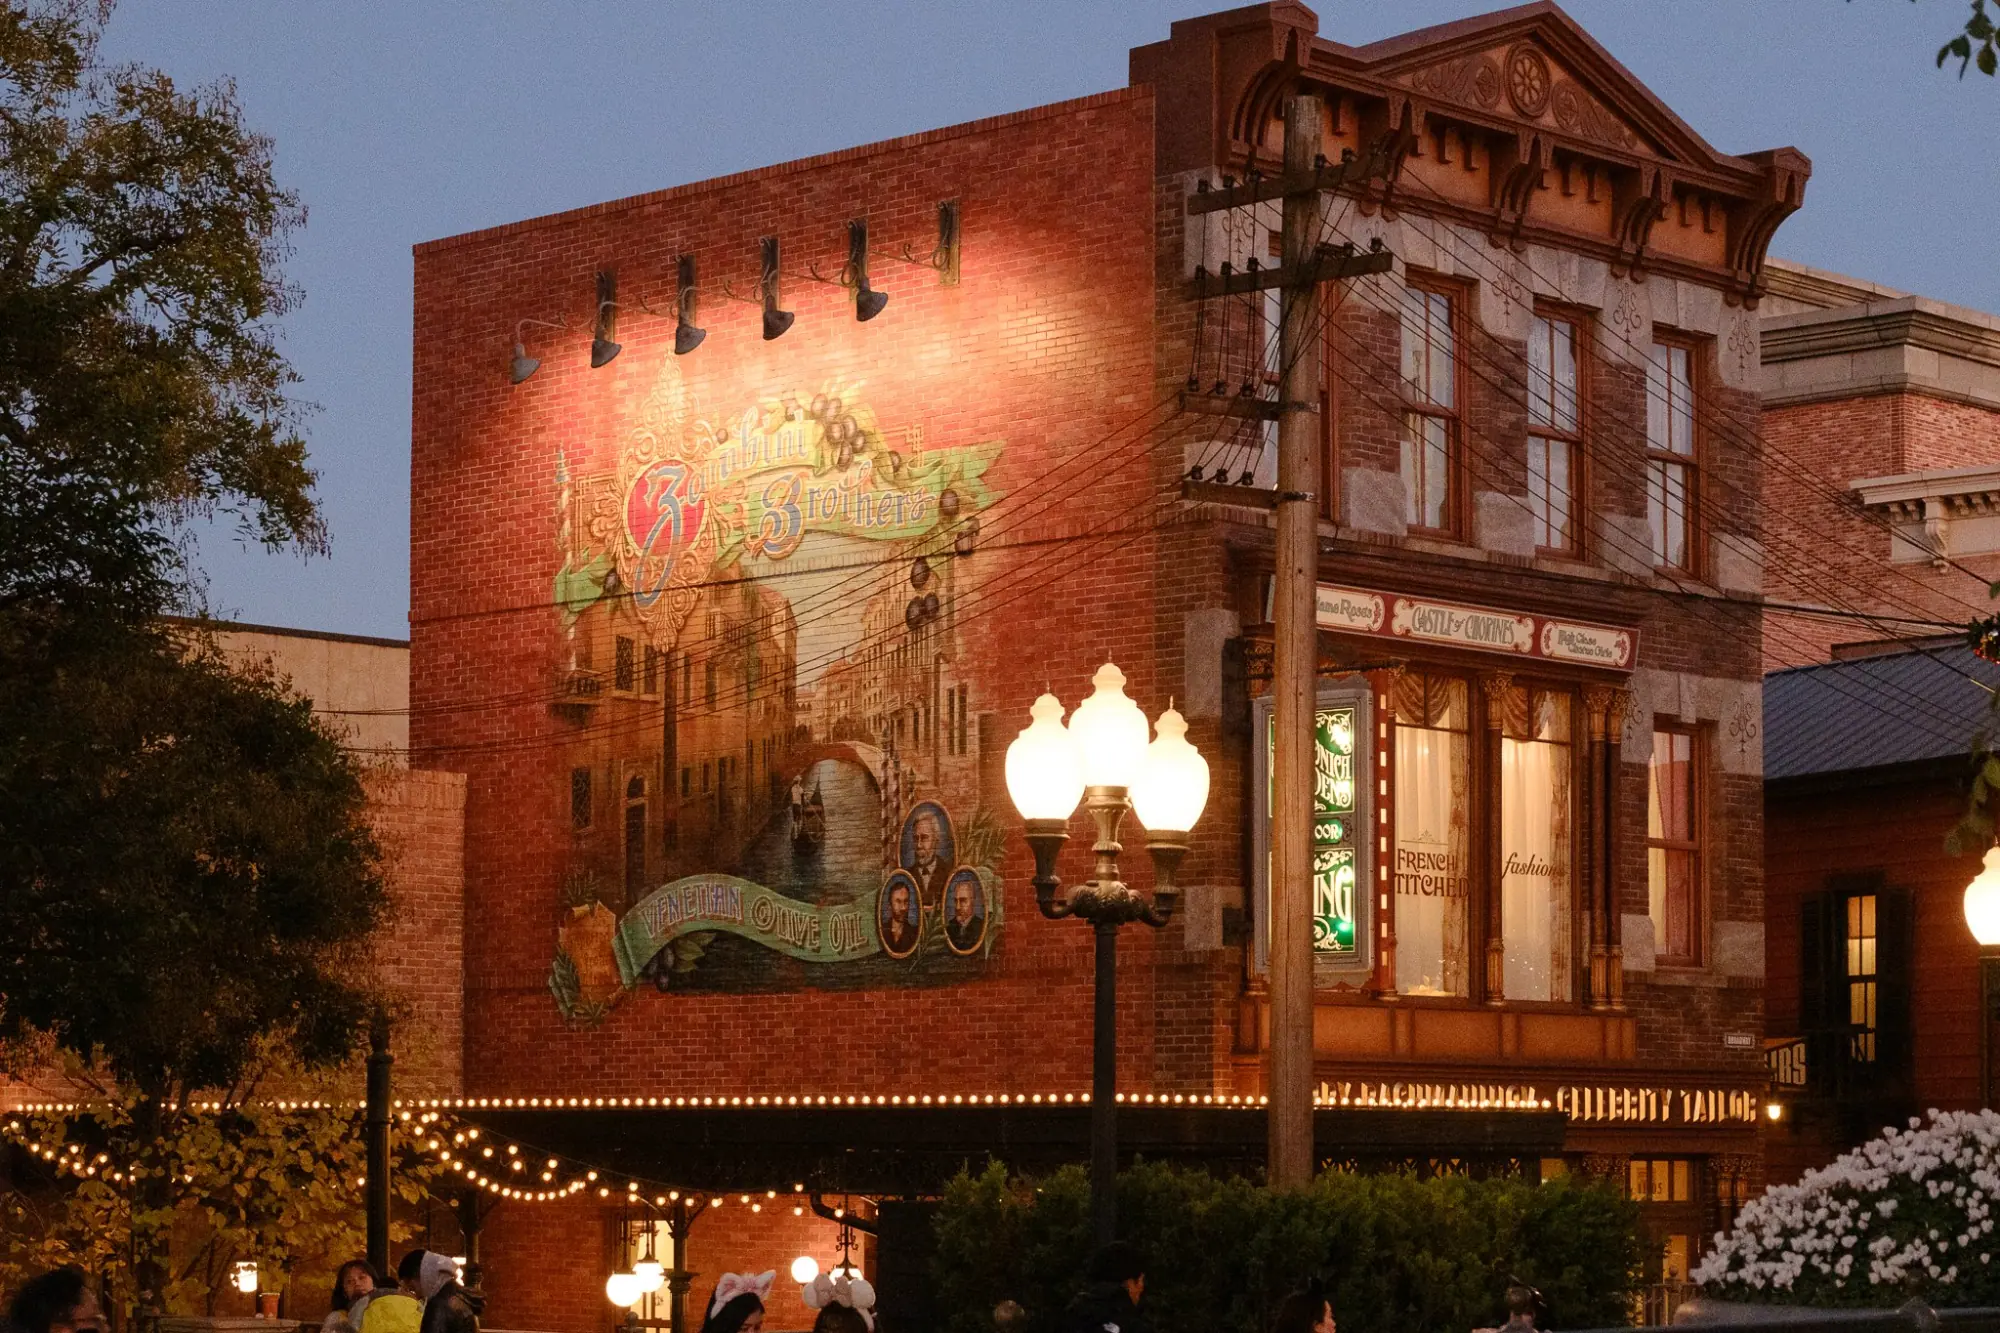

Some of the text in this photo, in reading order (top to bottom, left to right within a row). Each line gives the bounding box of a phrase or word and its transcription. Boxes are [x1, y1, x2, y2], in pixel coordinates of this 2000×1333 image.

[746, 459, 936, 559] Brothers
[1412, 606, 1454, 636] CASTLE
[1464, 614, 1515, 645] CHORINES
[1397, 848, 1455, 873] FRENCH
[638, 881, 868, 955] VENETIAN OLIVE OIL
[1764, 1043, 1806, 1085] IRS
[1557, 1086, 1672, 1122] CELEBRITY
[1680, 1089, 1756, 1123] TAILOR
